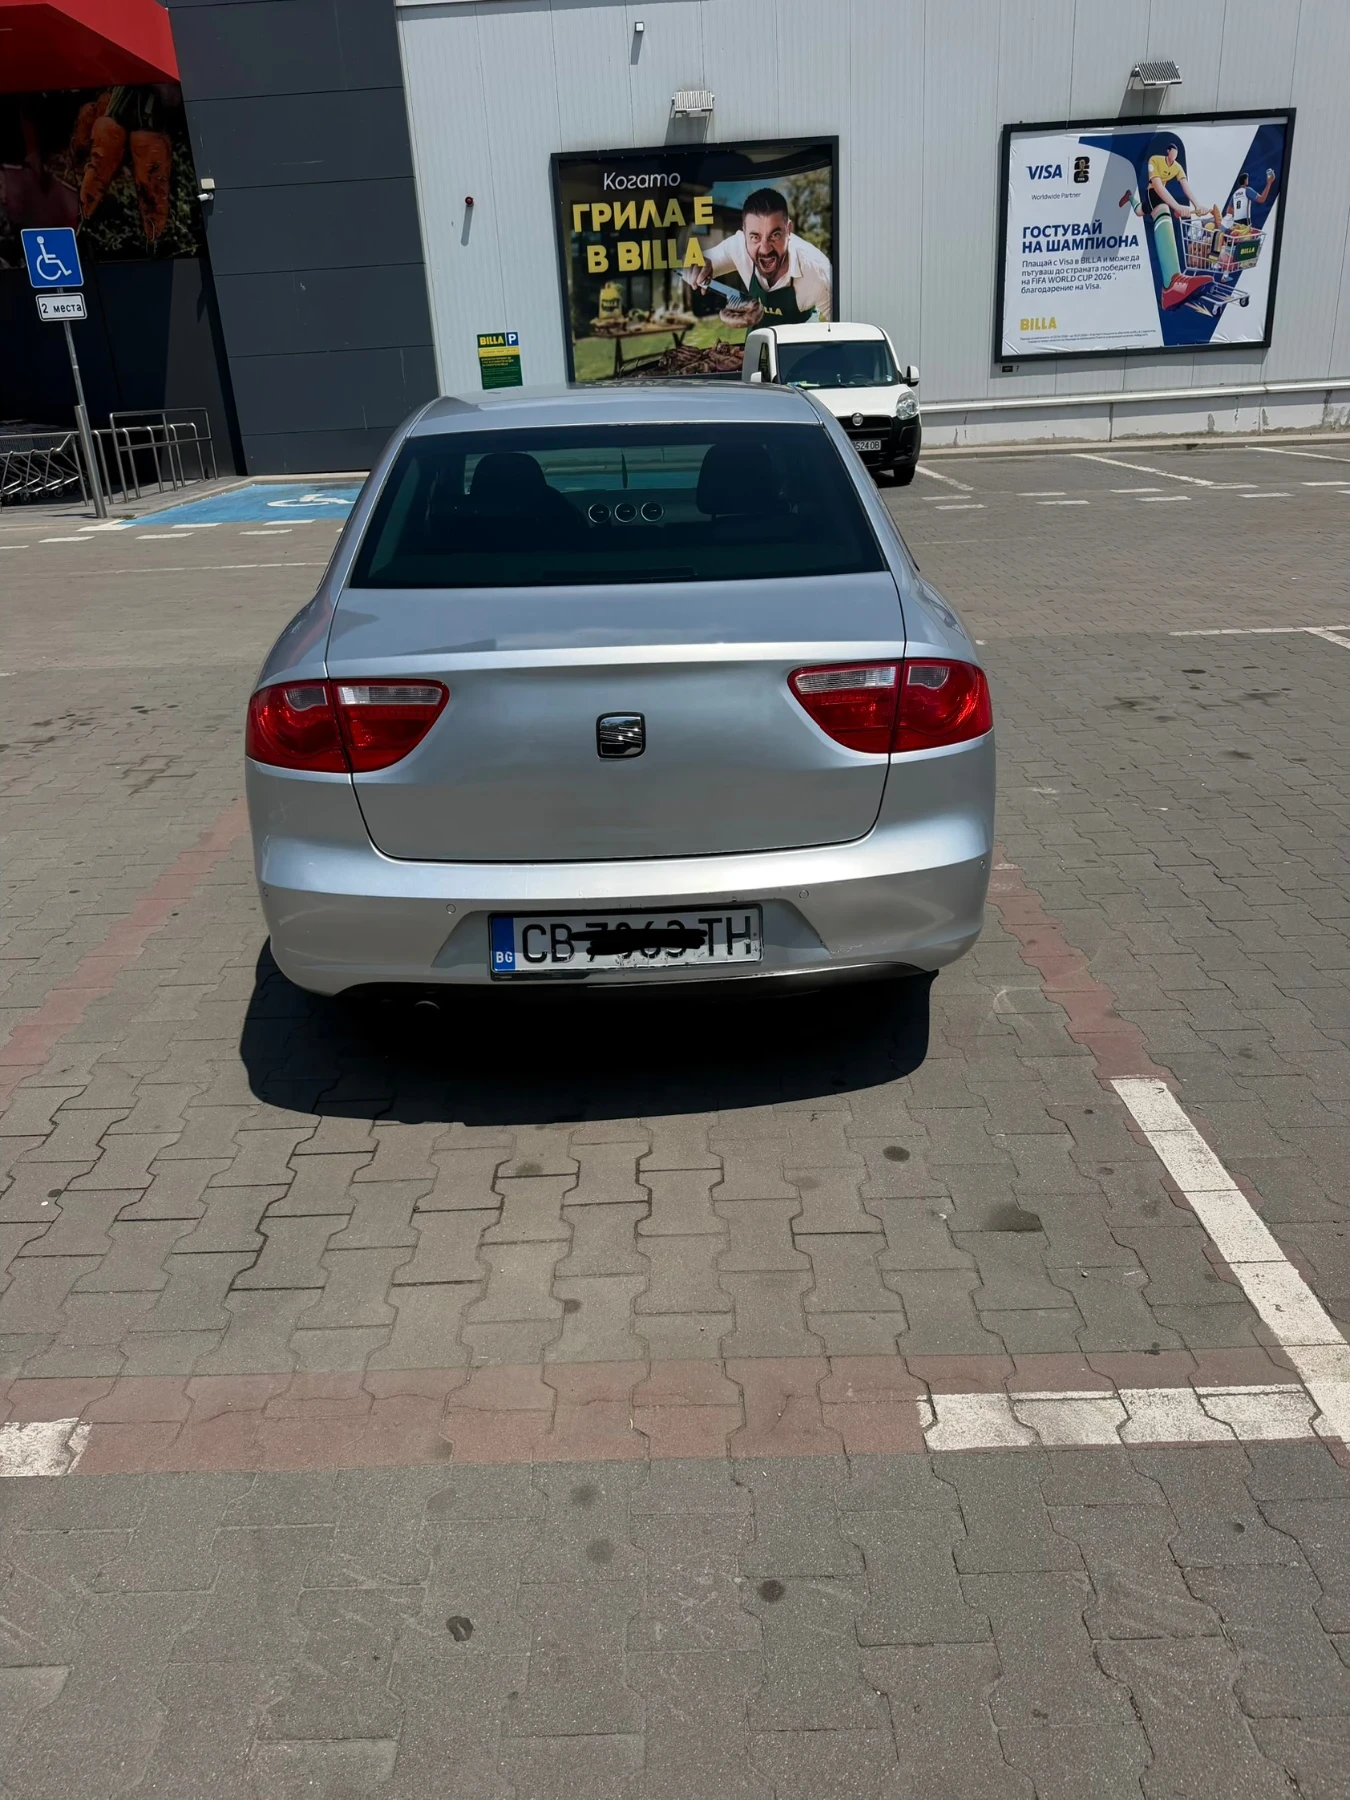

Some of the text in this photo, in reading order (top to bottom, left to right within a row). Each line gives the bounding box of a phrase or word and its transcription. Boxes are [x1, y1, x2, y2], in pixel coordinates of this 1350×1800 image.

[1025, 164, 1062, 180] VISA
[603, 172, 681, 191] Когато
[1031, 193, 1060, 201] Worldwide
[572, 195, 714, 233] ГРИЛА Е
[1023, 219, 1103, 239] ГОСТУВАЙ
[1022, 235, 1139, 254] НА ШАМПИОНА
[617, 237, 706, 272] BILLA
[1022, 259, 1052, 268] Плащай
[1058, 258, 1073, 266] Visa
[1021, 269, 1055, 278] пътуваш
[1065, 265, 1099, 275] страната
[1100, 263, 1141, 272] победител
[1031, 277, 1046, 285] FIFA
[1048, 275, 1076, 284] WORLD
[1077, 274, 1093, 282] CUP
[1021, 285, 1074, 294] благодарение
[1085, 282, 1102, 290] Visa.
[41, 303, 83, 314] 2 места
[1020, 317, 1057, 331] BILLA
[479, 333, 517, 345] BILLA P
[496, 951, 513, 964] BG
